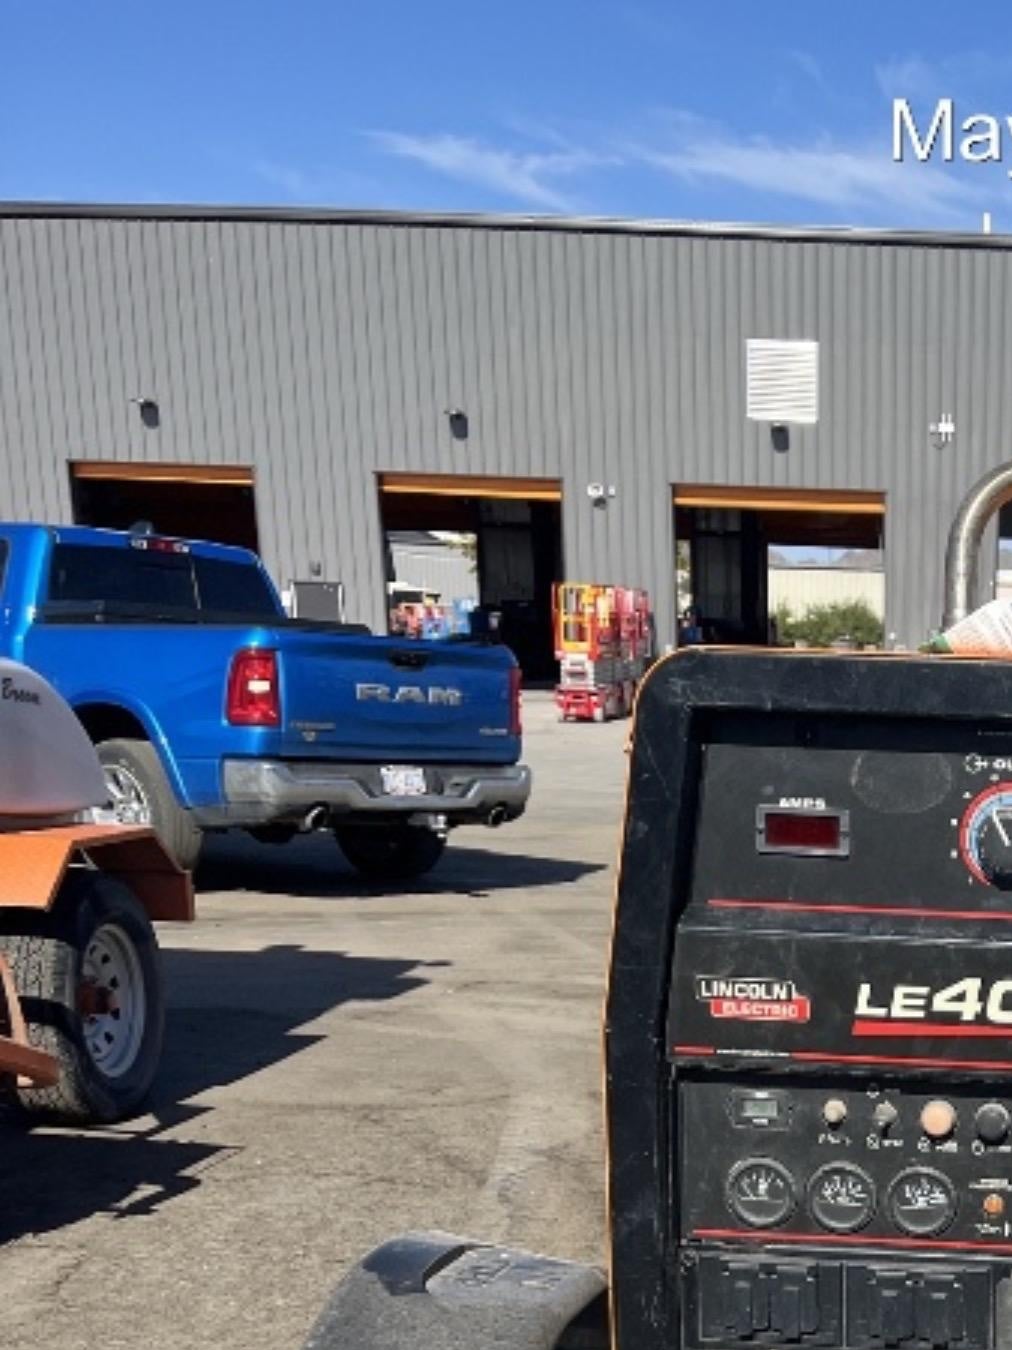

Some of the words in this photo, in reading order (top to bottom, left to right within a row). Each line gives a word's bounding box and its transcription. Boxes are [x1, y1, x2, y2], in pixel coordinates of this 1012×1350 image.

[356, 682, 463, 706] RAM
[700, 980, 790, 1000] LINCOLN
[720, 1001, 800, 1018] ELECTRIC
